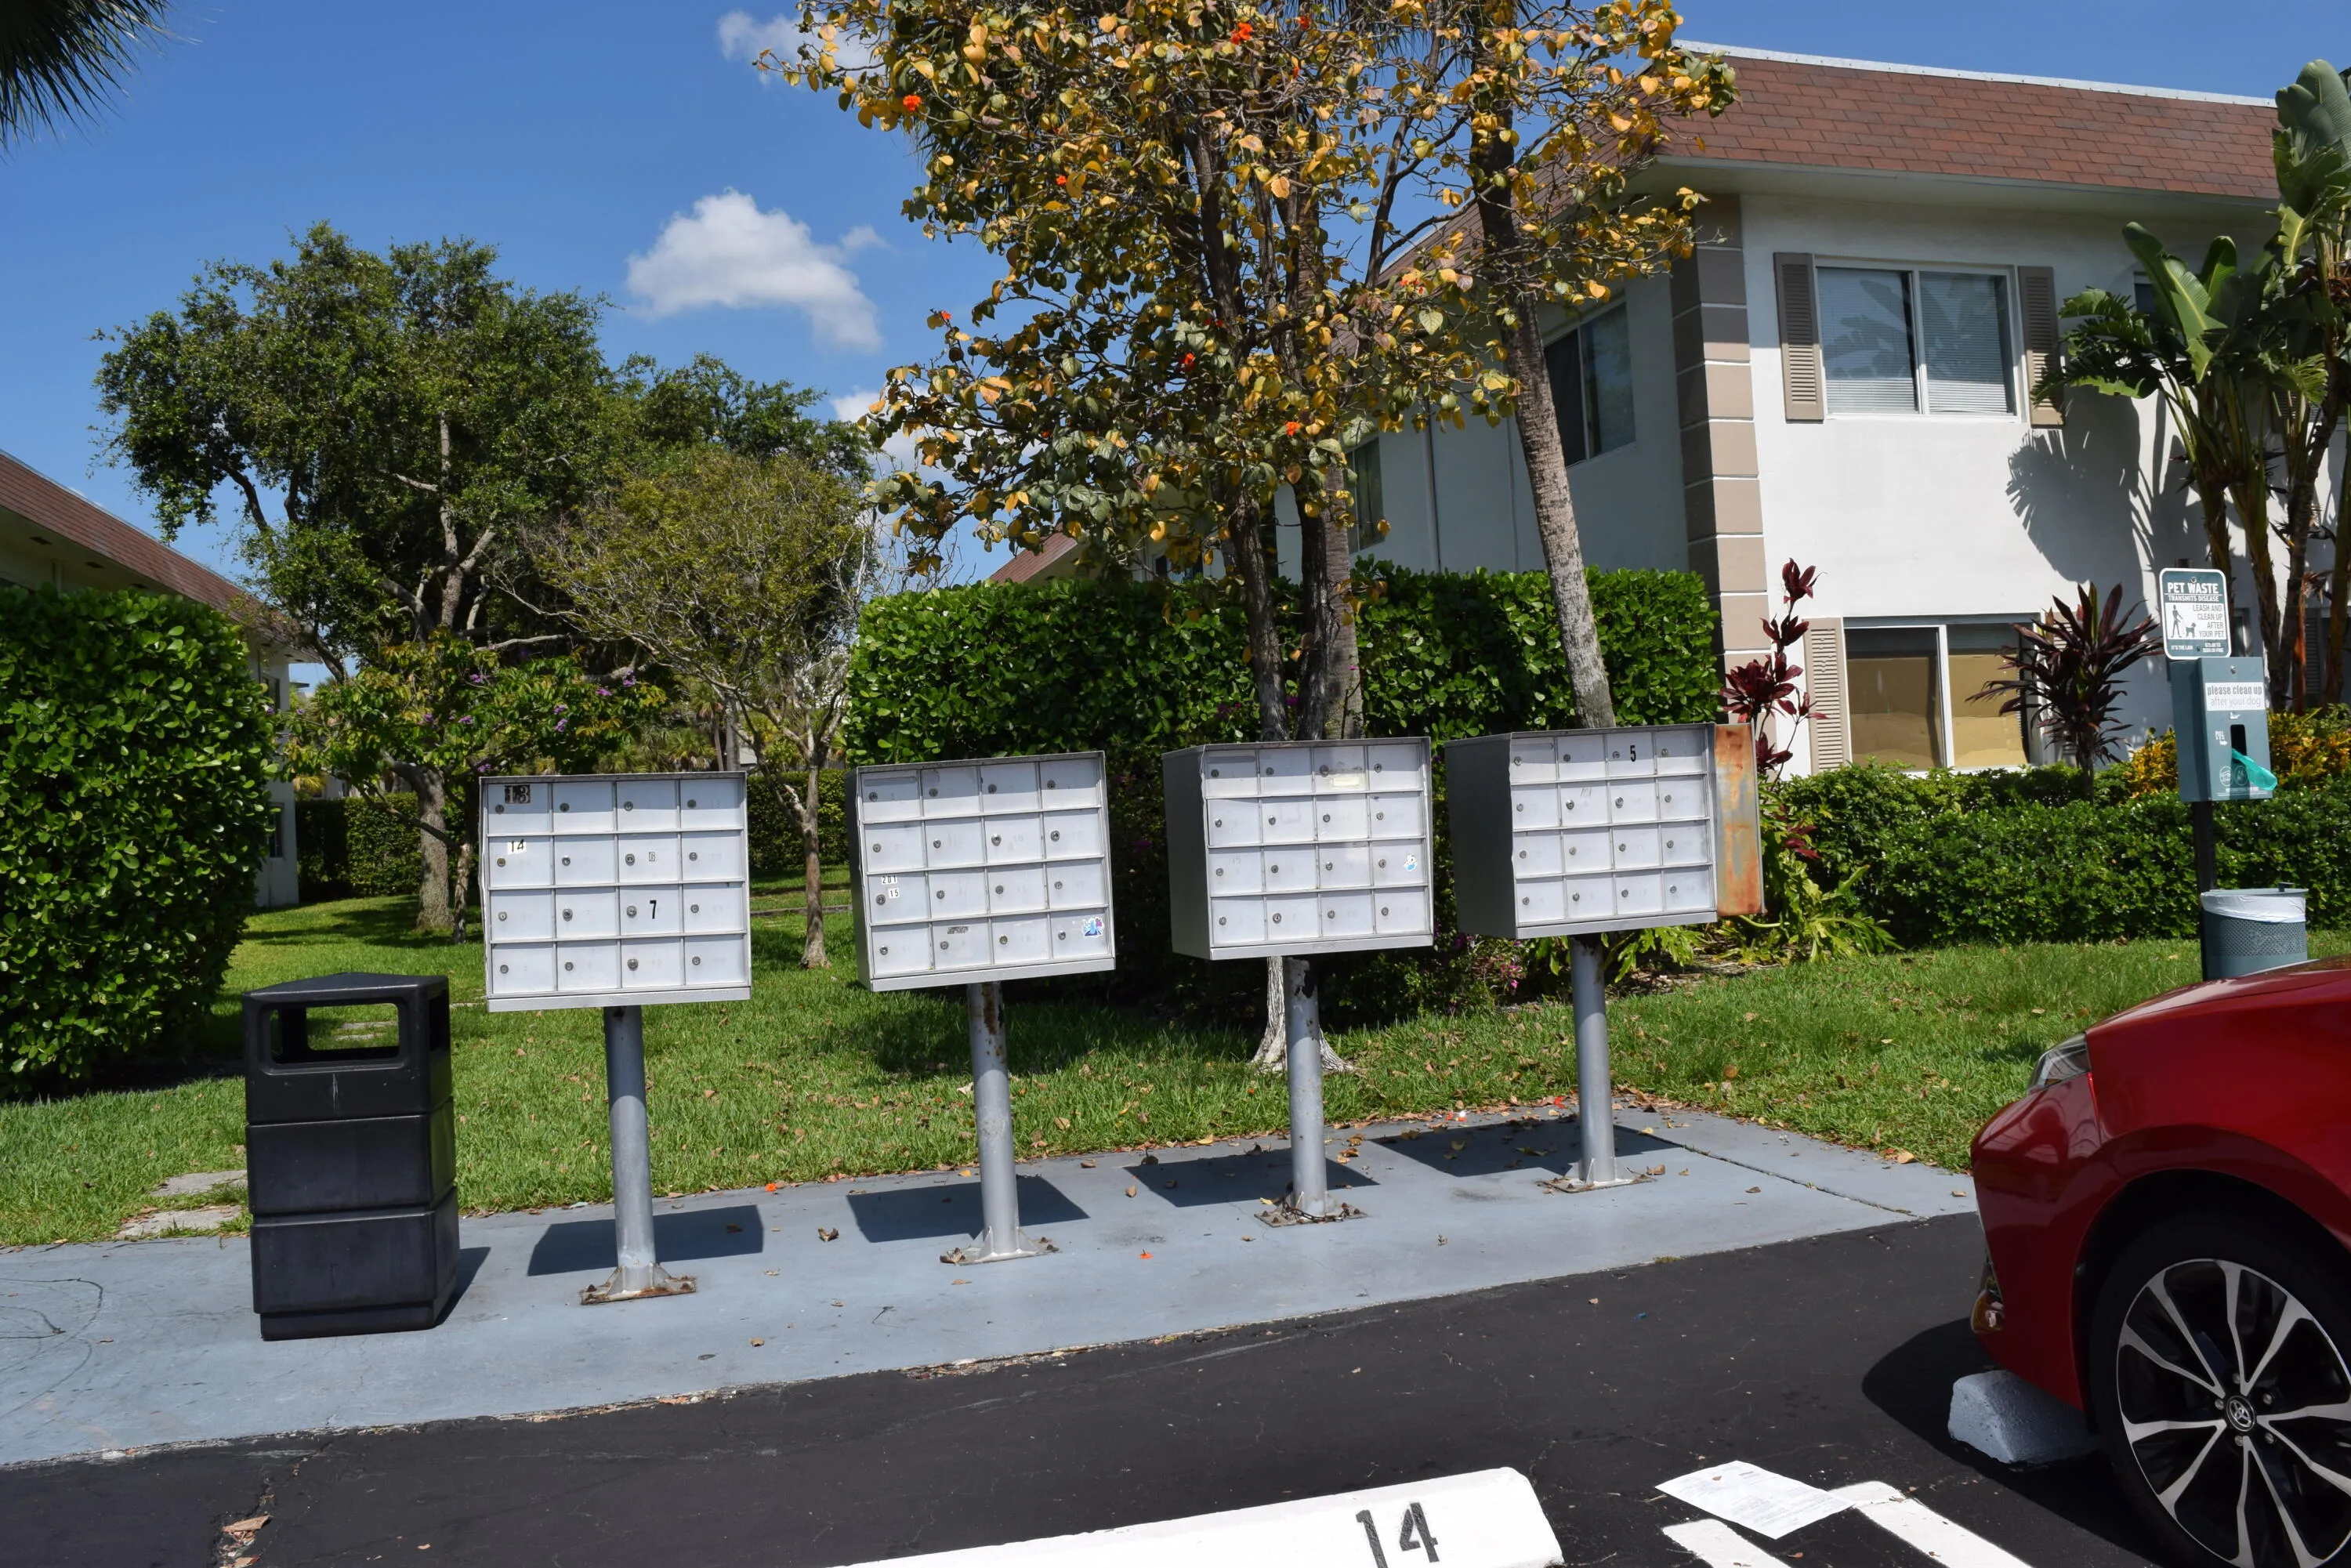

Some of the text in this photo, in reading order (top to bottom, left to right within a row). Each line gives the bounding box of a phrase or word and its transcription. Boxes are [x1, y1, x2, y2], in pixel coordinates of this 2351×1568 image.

[2168, 582, 2219, 593] PET WASTE
[2207, 685, 2262, 696] please clean up
[2210, 697, 2261, 708] after your dog
[1629, 744, 1636, 762] 5
[507, 785, 531, 803] 13
[511, 838, 524, 853] 14
[882, 875, 897, 884] 201
[889, 889, 899, 897] 15
[649, 900, 657, 919] 7
[1355, 1502, 1440, 1568] 14
